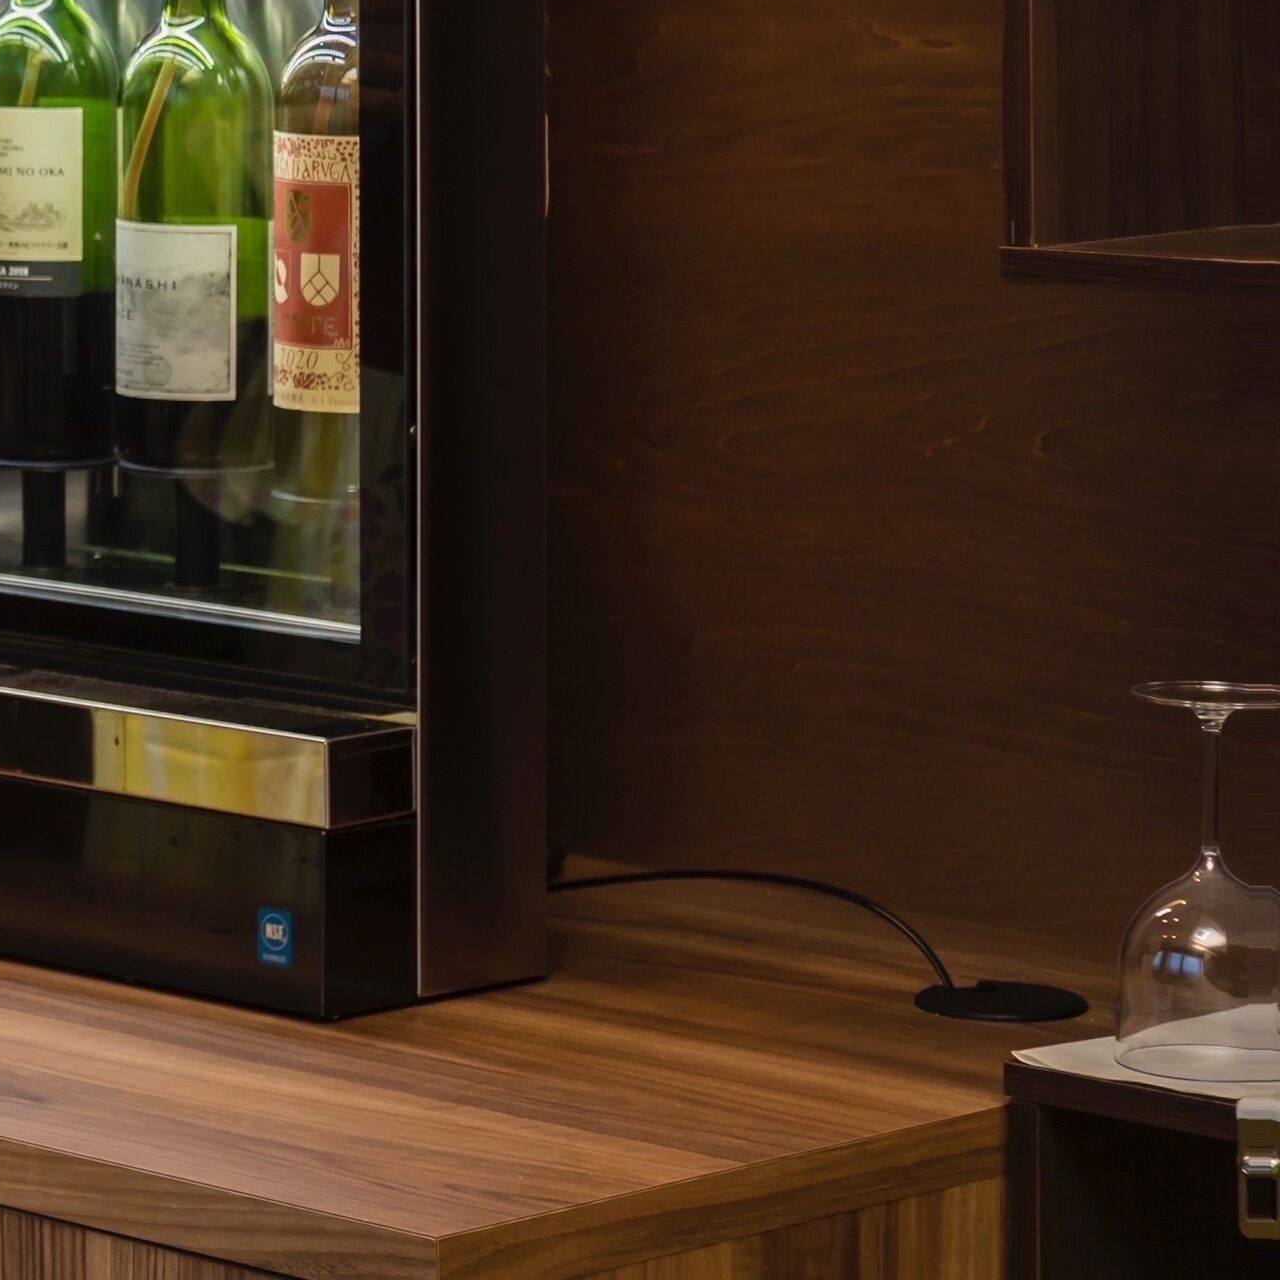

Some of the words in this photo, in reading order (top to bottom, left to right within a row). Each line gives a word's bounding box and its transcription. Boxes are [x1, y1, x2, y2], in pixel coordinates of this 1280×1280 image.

[16, 166, 34, 177] NO
[39, 167, 65, 177] OKA
[279, 348, 319, 371] 2020
